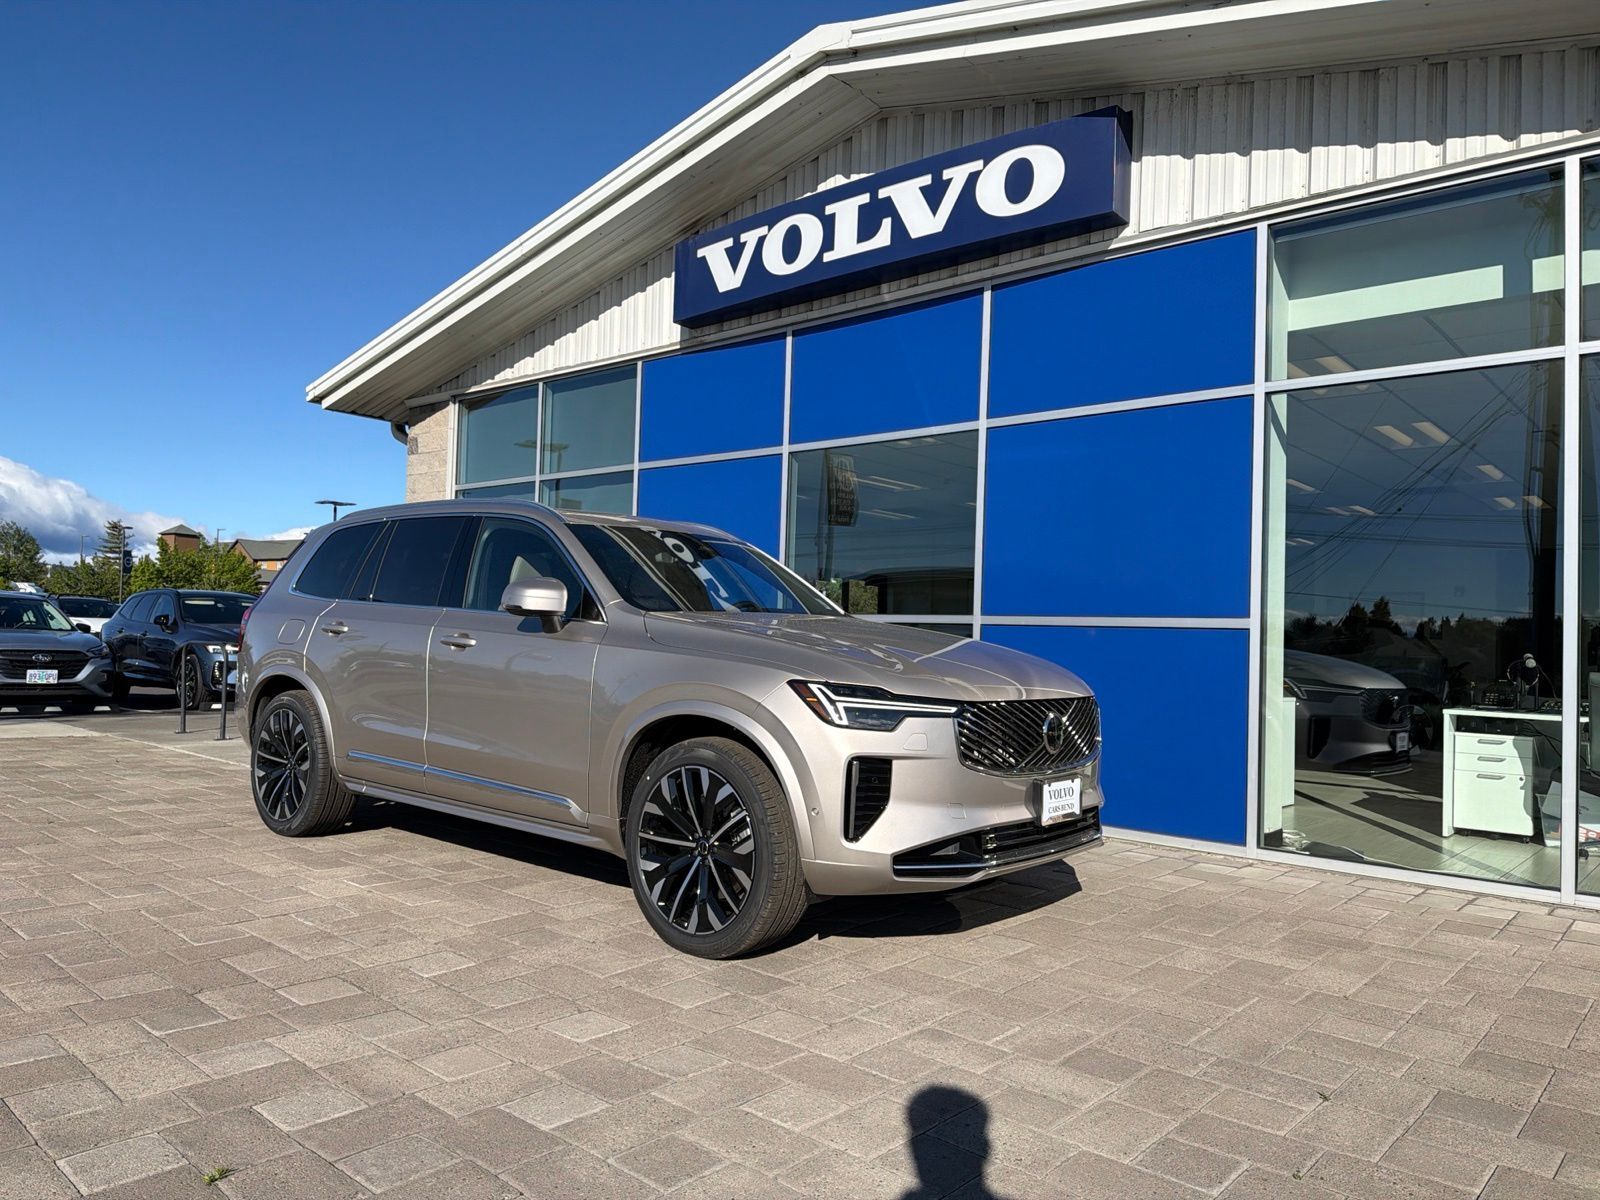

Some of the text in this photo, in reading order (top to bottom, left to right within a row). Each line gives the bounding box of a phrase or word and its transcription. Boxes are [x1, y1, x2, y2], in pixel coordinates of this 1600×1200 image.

[697, 144, 1066, 293] VOLVO
[1048, 786, 1074, 800] VOLVO
[1048, 803, 1074, 814] CARS BEND
